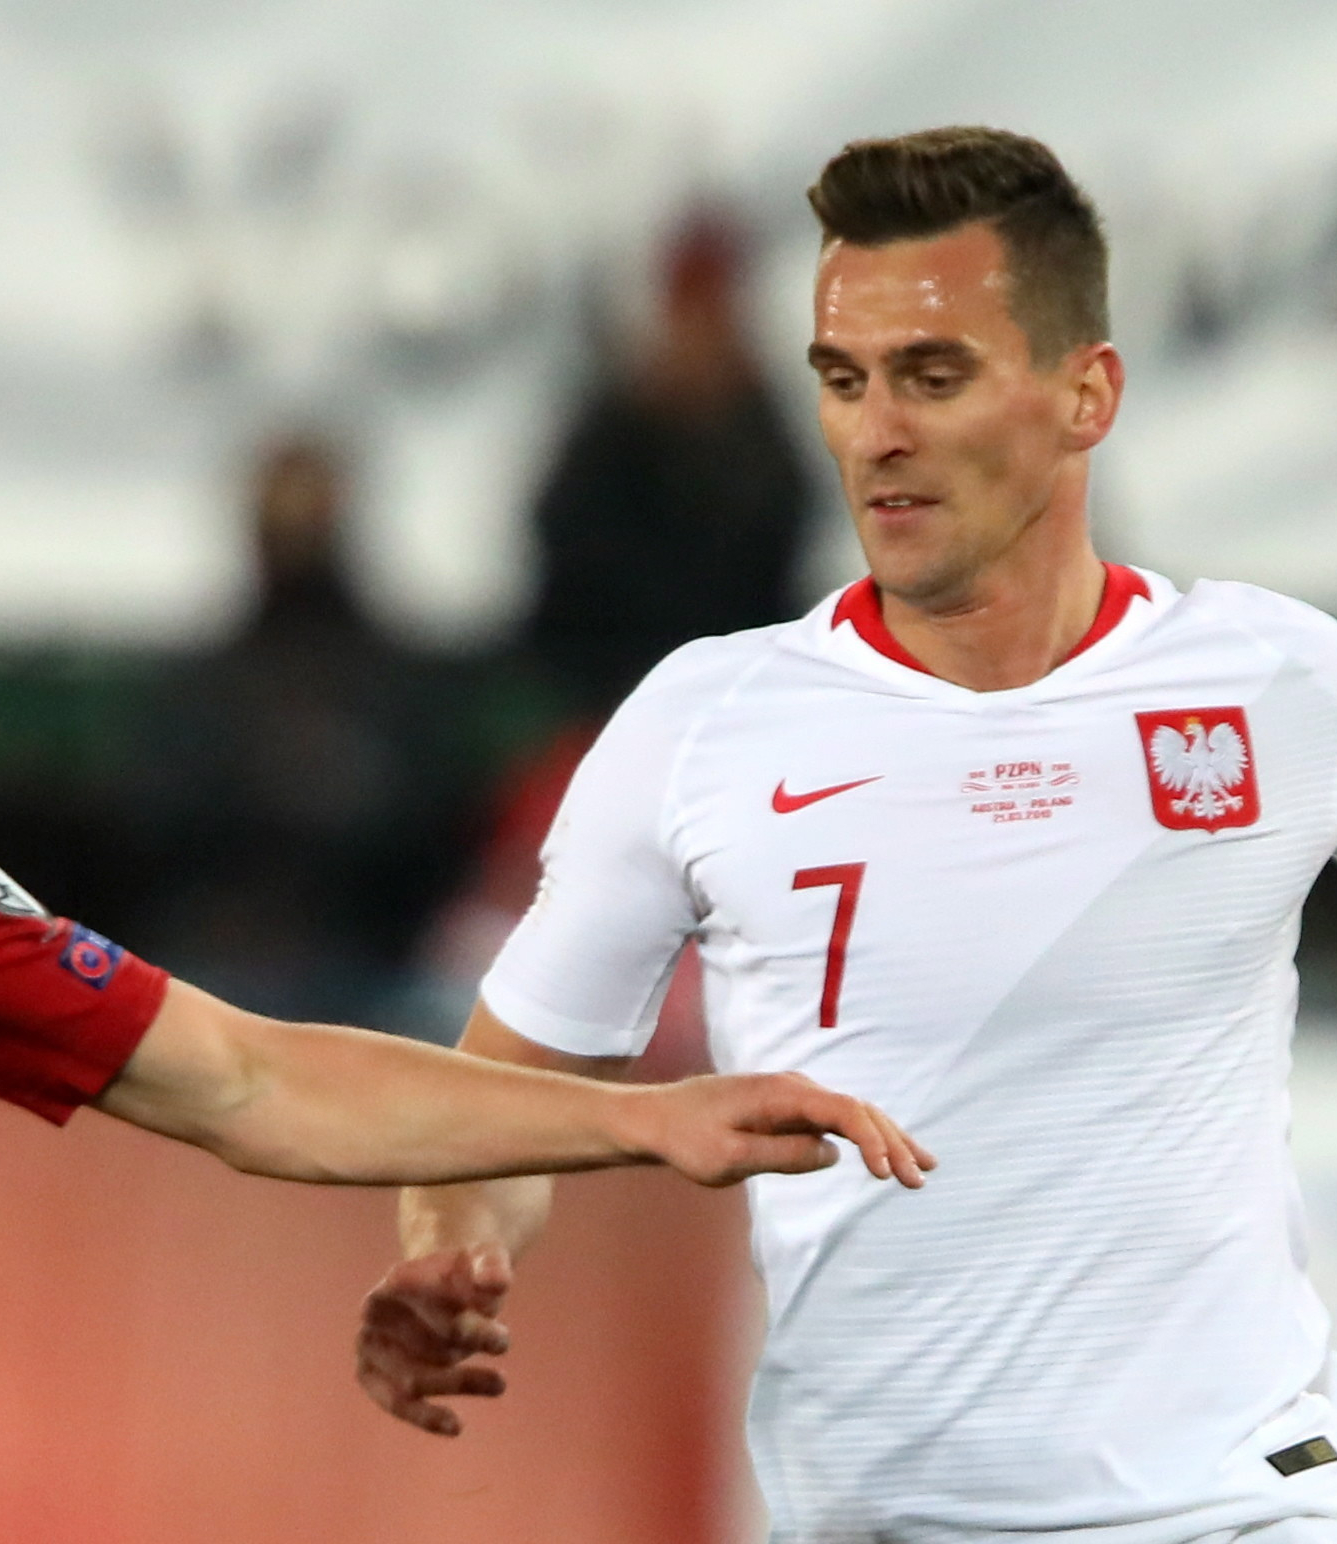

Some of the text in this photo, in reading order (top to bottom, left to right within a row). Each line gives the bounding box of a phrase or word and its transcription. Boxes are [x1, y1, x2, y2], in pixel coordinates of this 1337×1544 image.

[995, 761, 1042, 778] PZPN
[1030, 796, 1073, 808] POLAND
[792, 862, 867, 1028] 7
